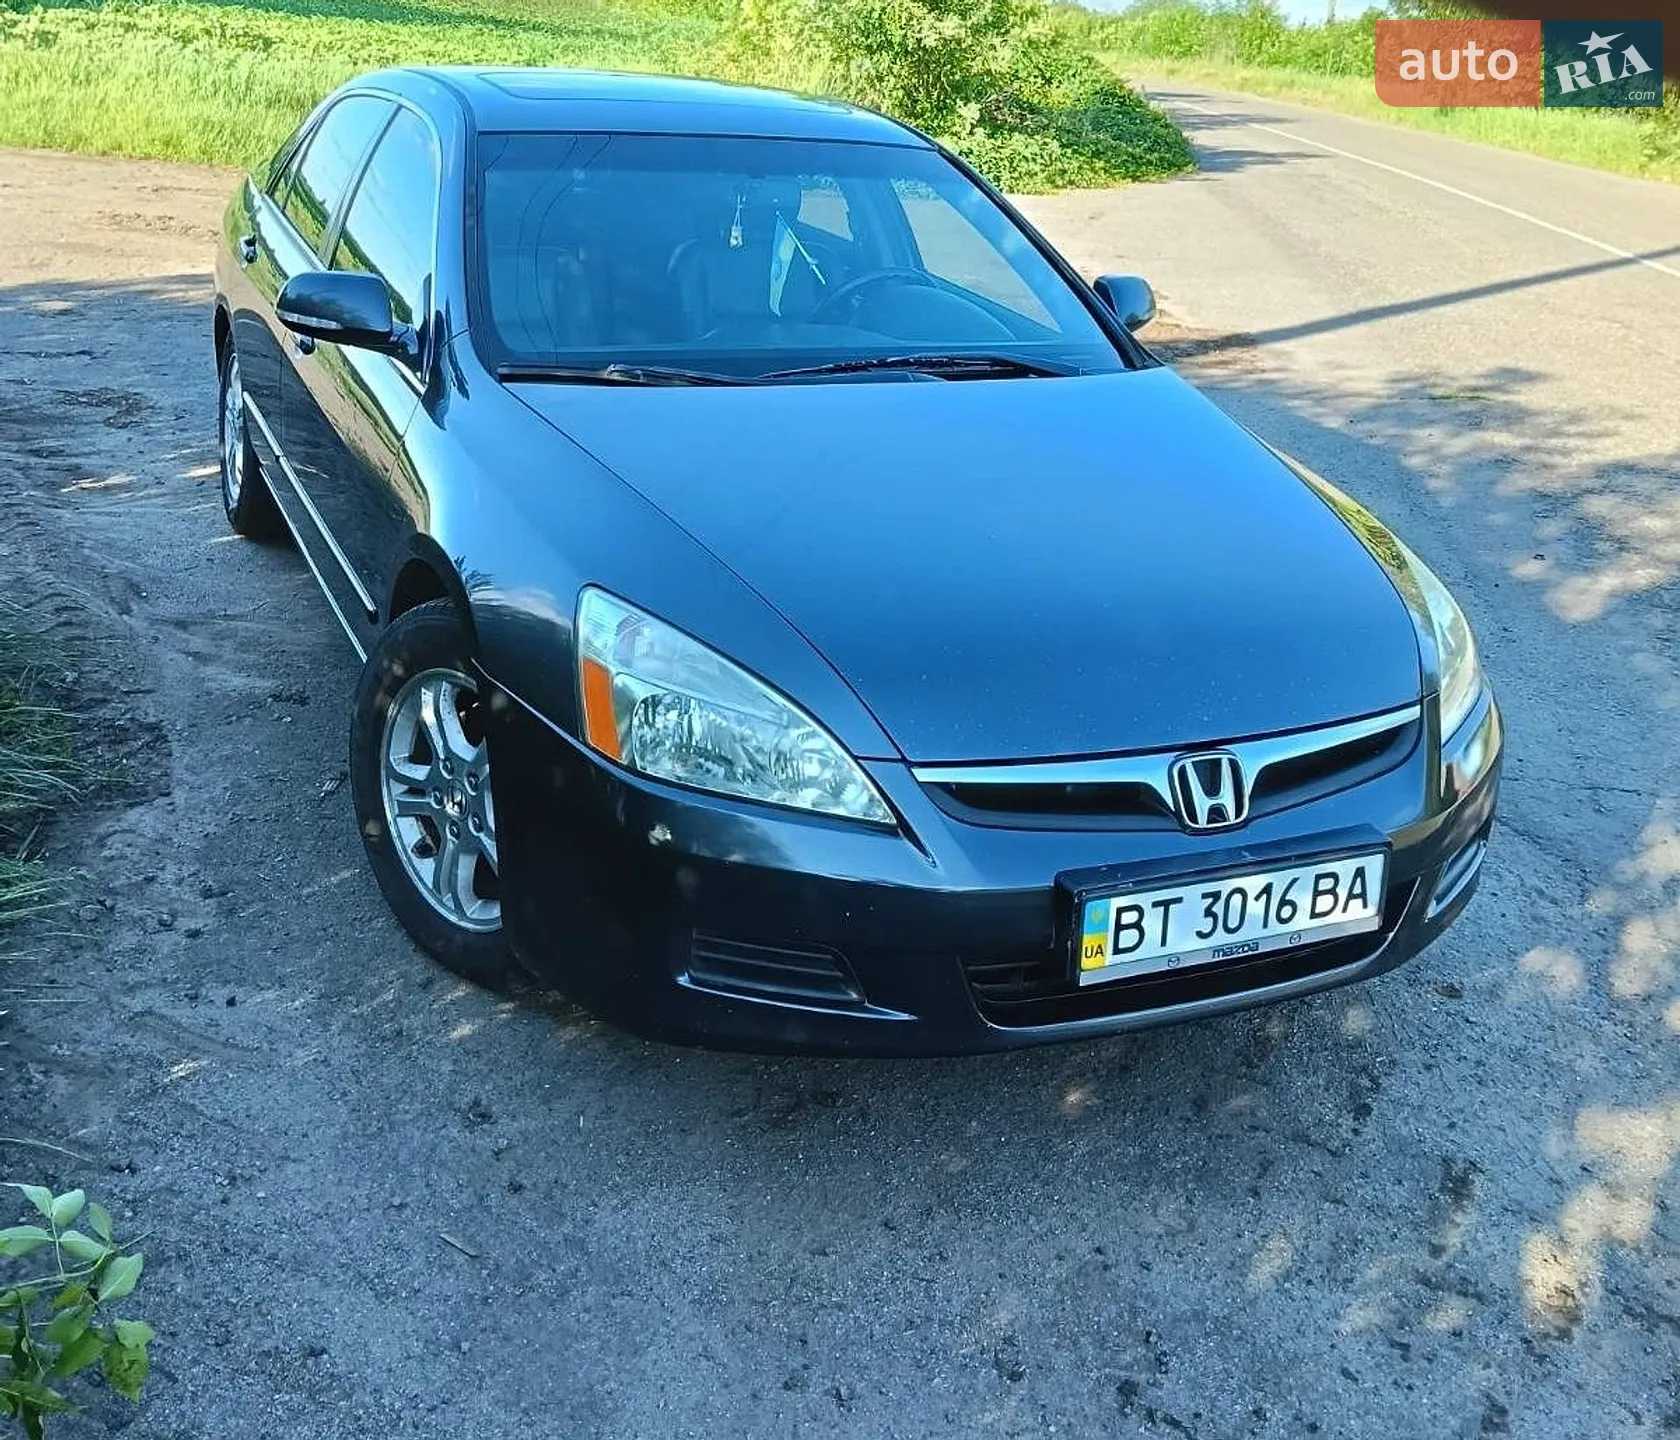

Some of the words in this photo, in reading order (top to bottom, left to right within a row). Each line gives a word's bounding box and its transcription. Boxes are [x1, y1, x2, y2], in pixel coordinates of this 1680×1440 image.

[1111, 896, 1184, 956] BT
[1195, 876, 1301, 940] 3016
[1309, 866, 1369, 921] BA
[1084, 943, 1105, 960] UA
[1211, 942, 1260, 959] mazda
